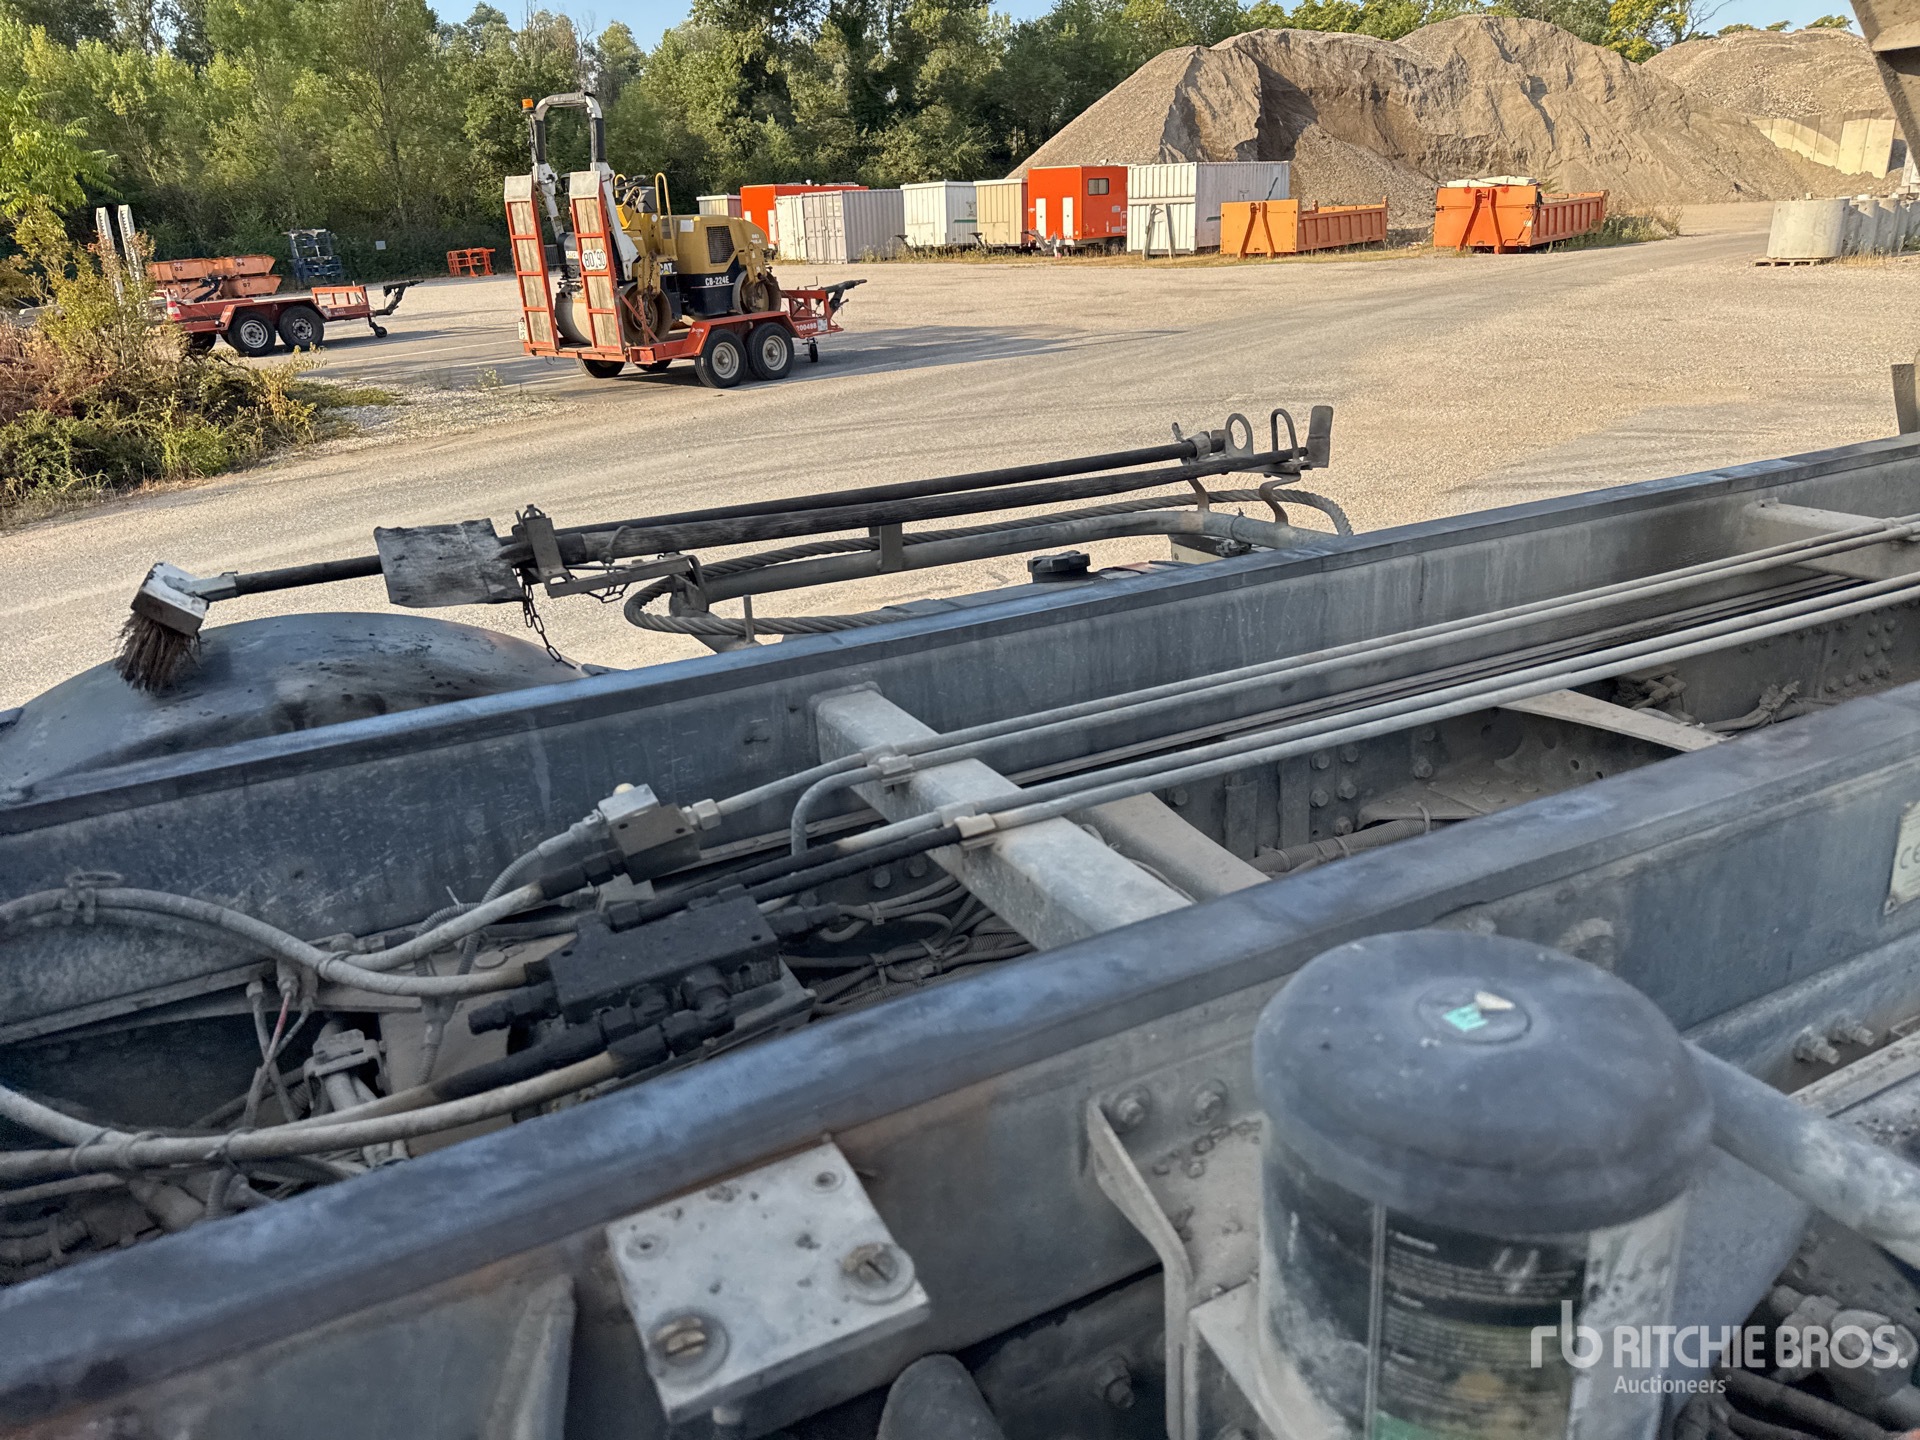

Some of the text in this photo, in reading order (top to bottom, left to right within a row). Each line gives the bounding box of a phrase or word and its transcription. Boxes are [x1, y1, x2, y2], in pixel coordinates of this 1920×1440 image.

[584, 252, 595, 268] 80
[596, 251, 606, 267] 90
[660, 262, 673, 275] CAT
[705, 275, 730, 286] CB-224E
